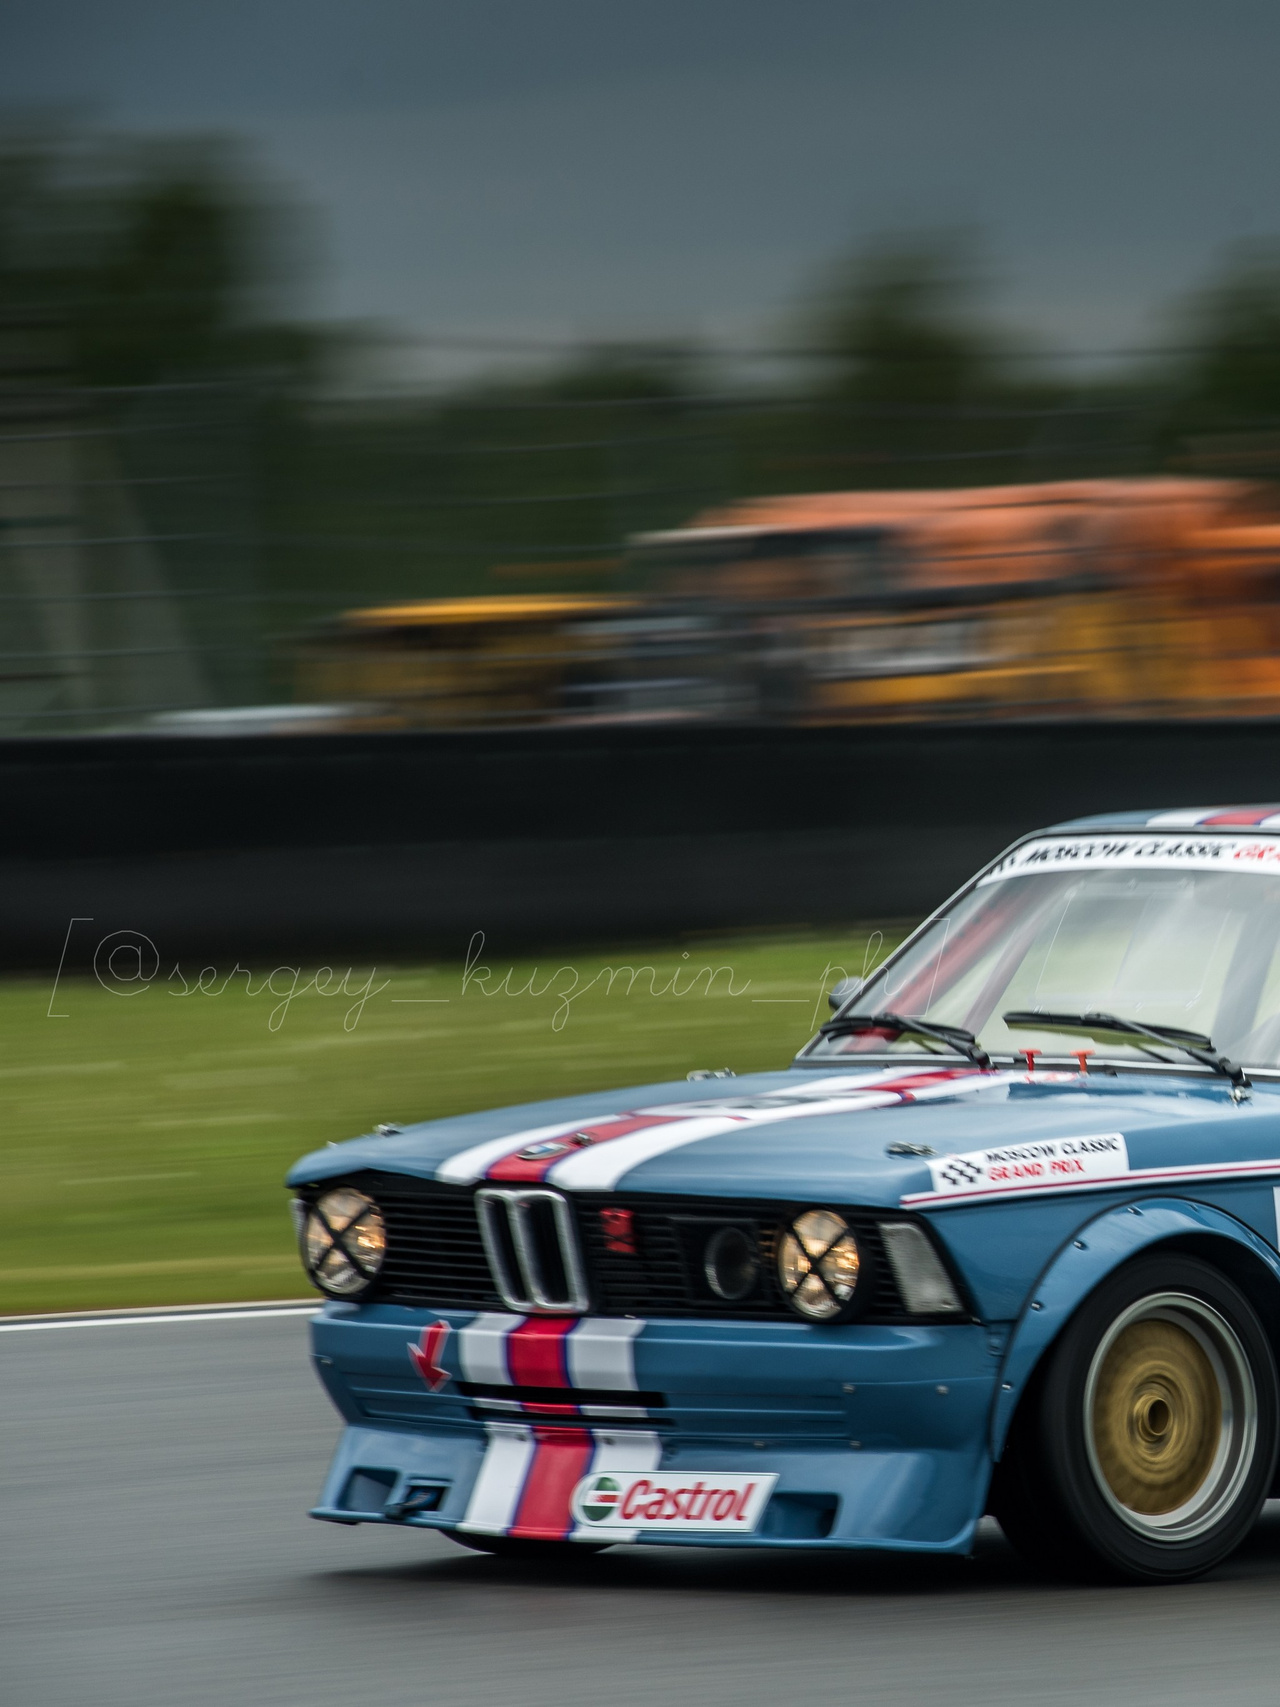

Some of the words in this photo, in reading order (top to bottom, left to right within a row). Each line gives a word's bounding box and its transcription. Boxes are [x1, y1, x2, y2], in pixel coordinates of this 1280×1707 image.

[985, 1144, 1057, 1163] MOSCOW
[1061, 1136, 1120, 1155] CLASSIC
[988, 1162, 1044, 1182] GRAND
[1050, 1158, 1086, 1175] PRIX
[621, 1479, 757, 1521] Castrol
